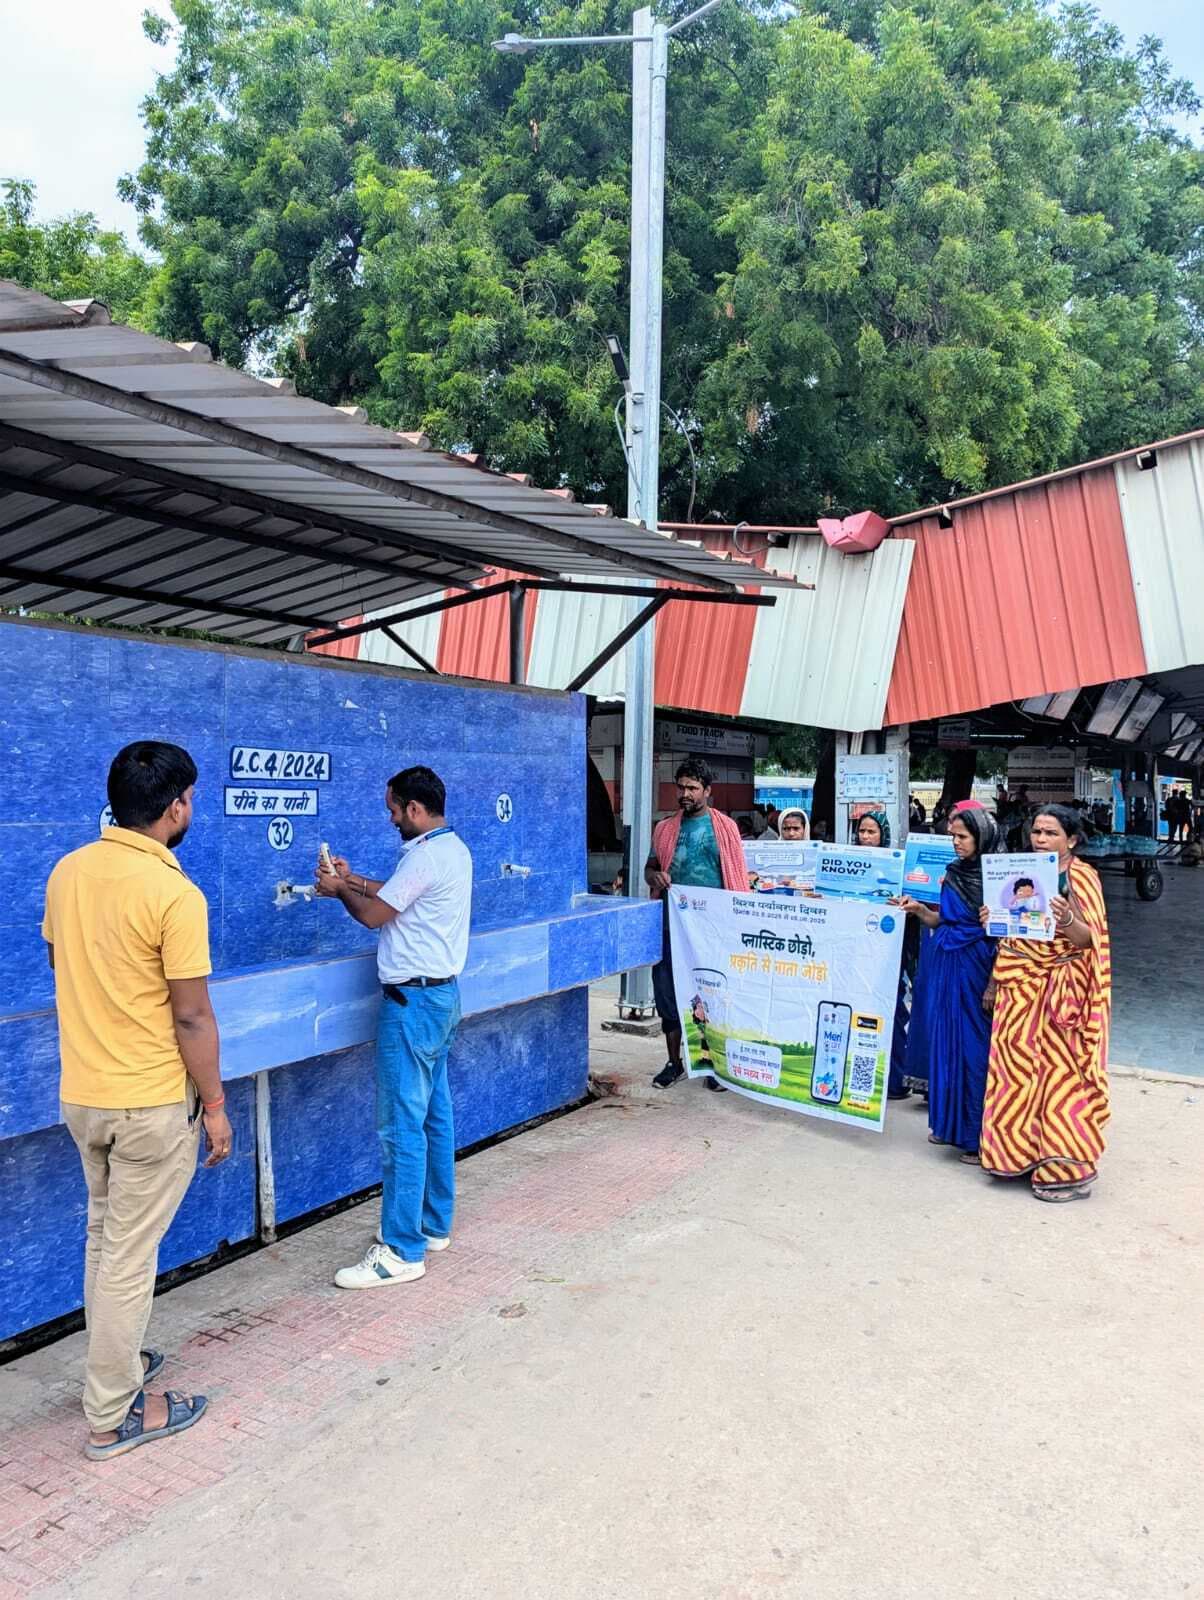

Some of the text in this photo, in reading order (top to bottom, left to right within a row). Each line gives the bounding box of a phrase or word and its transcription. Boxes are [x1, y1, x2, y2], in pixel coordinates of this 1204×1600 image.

[677, 725, 699, 736] FOOD
[232, 750, 325, 780] L.C.4/2024
[233, 790, 310, 810] पीने का पानी
[499, 799, 511, 820] 34
[271, 821, 290, 846] 32
[820, 865, 866, 877] KNOW?
[821, 857, 873, 869] DID YOU
[741, 929, 817, 960] प्लास्टिक छोड़ो,
[761, 953, 771, 974] से
[775, 958, 798, 977] नाता
[823, 1030, 843, 1042] Meri
